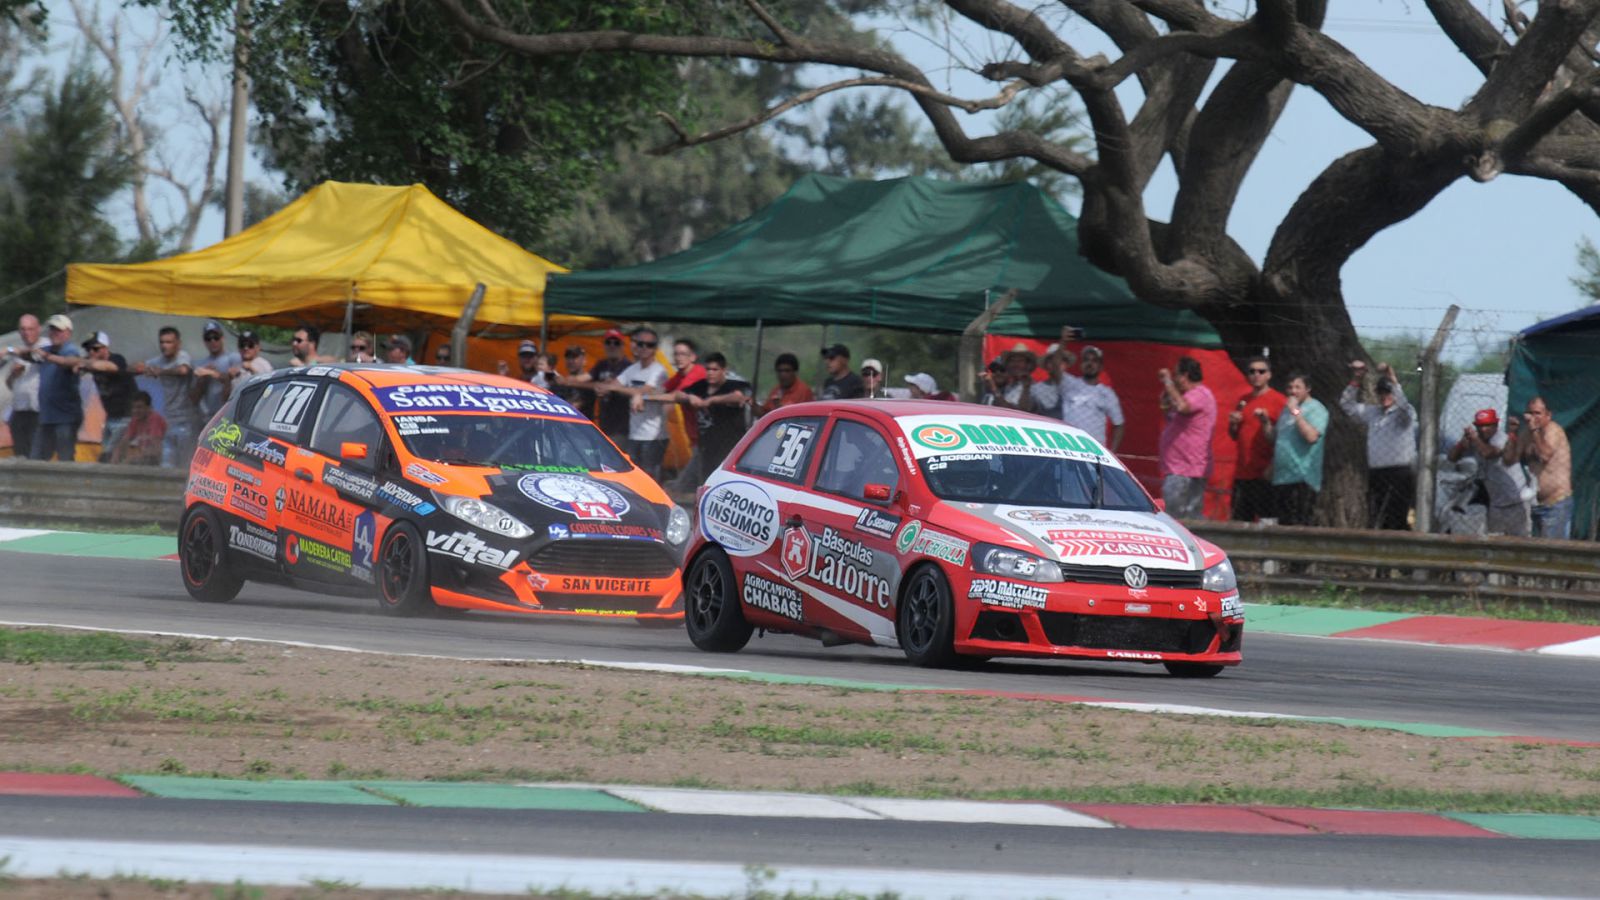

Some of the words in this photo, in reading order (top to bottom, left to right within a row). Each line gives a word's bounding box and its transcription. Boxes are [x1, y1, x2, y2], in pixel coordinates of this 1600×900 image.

[274, 385, 315, 424] 11
[389, 391, 454, 408] San
[458, 391, 577, 413] Agustin
[397, 384, 549, 400] CARNICERIAS
[772, 427, 812, 468] 36
[959, 424, 1021, 446] DON
[1022, 427, 1104, 455] ITALO
[976, 444, 1028, 454] INSUMOS
[1031, 447, 1061, 457] PARA
[233, 482, 268, 507] PATO
[724, 490, 774, 523] PRONTO
[288, 488, 346, 529] NAMARA
[707, 501, 770, 541] INSUMOS
[501, 519, 511, 529] 11
[426, 530, 520, 568] vittal
[821, 528, 873, 566] Básculas
[1051, 531, 1181, 547] TRANSPORTE
[1104, 542, 1186, 561] CASILDA
[808, 537, 890, 609] Latorre
[1013, 559, 1036, 576] 36
[563, 578, 590, 590] SAN
[595, 579, 651, 592] VICENTE
[744, 574, 796, 600] AGROCAMPOS
[970, 579, 997, 592] PEDRO
[744, 586, 798, 619] CHABAS
[1107, 651, 1162, 659] CASILDA
